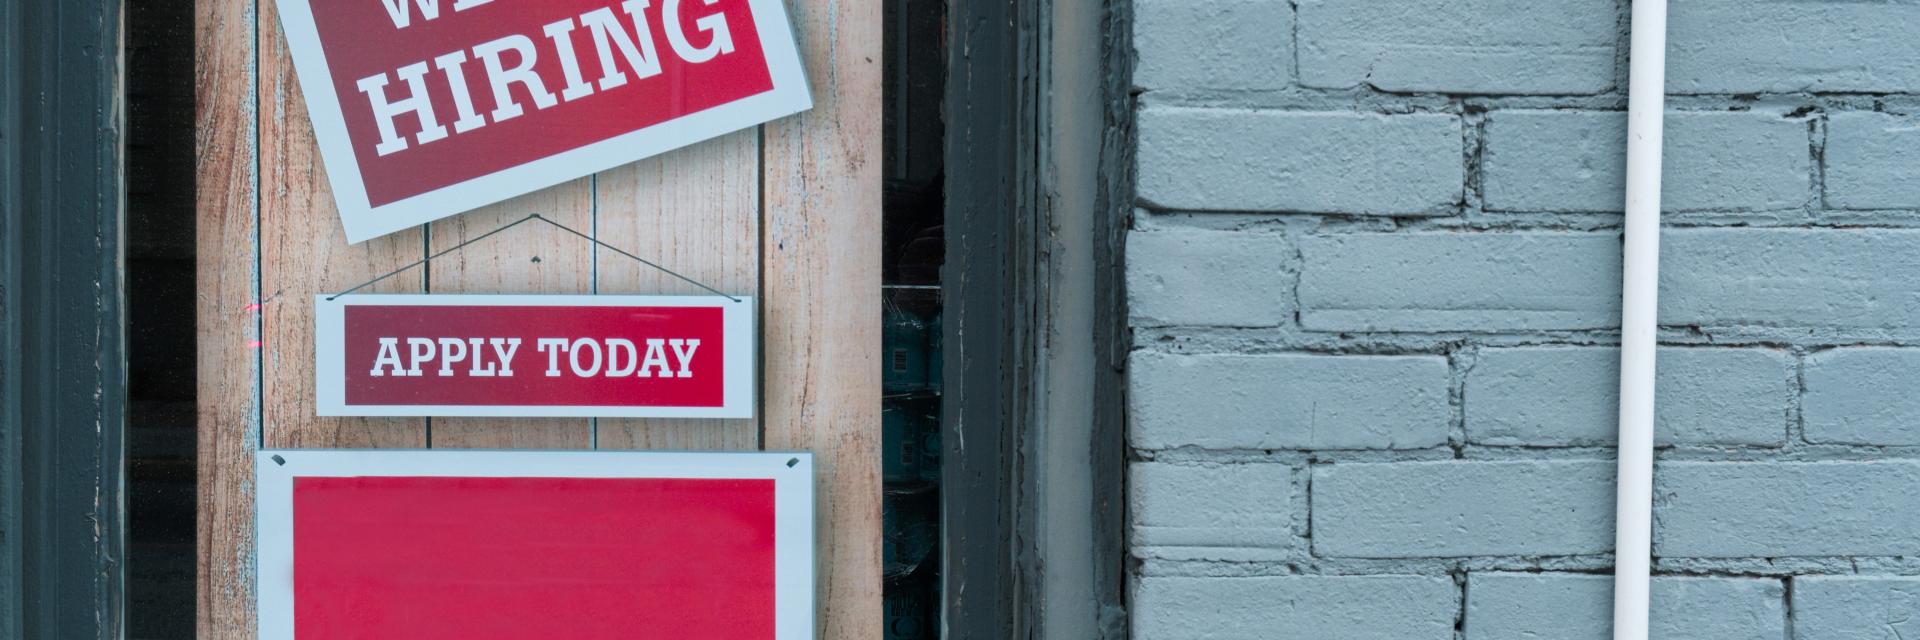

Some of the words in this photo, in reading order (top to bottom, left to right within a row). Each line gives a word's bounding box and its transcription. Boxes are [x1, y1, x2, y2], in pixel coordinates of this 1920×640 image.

[356, 0, 735, 157] HIRING
[370, 338, 521, 377] APPLY
[537, 338, 701, 378] TODAY
